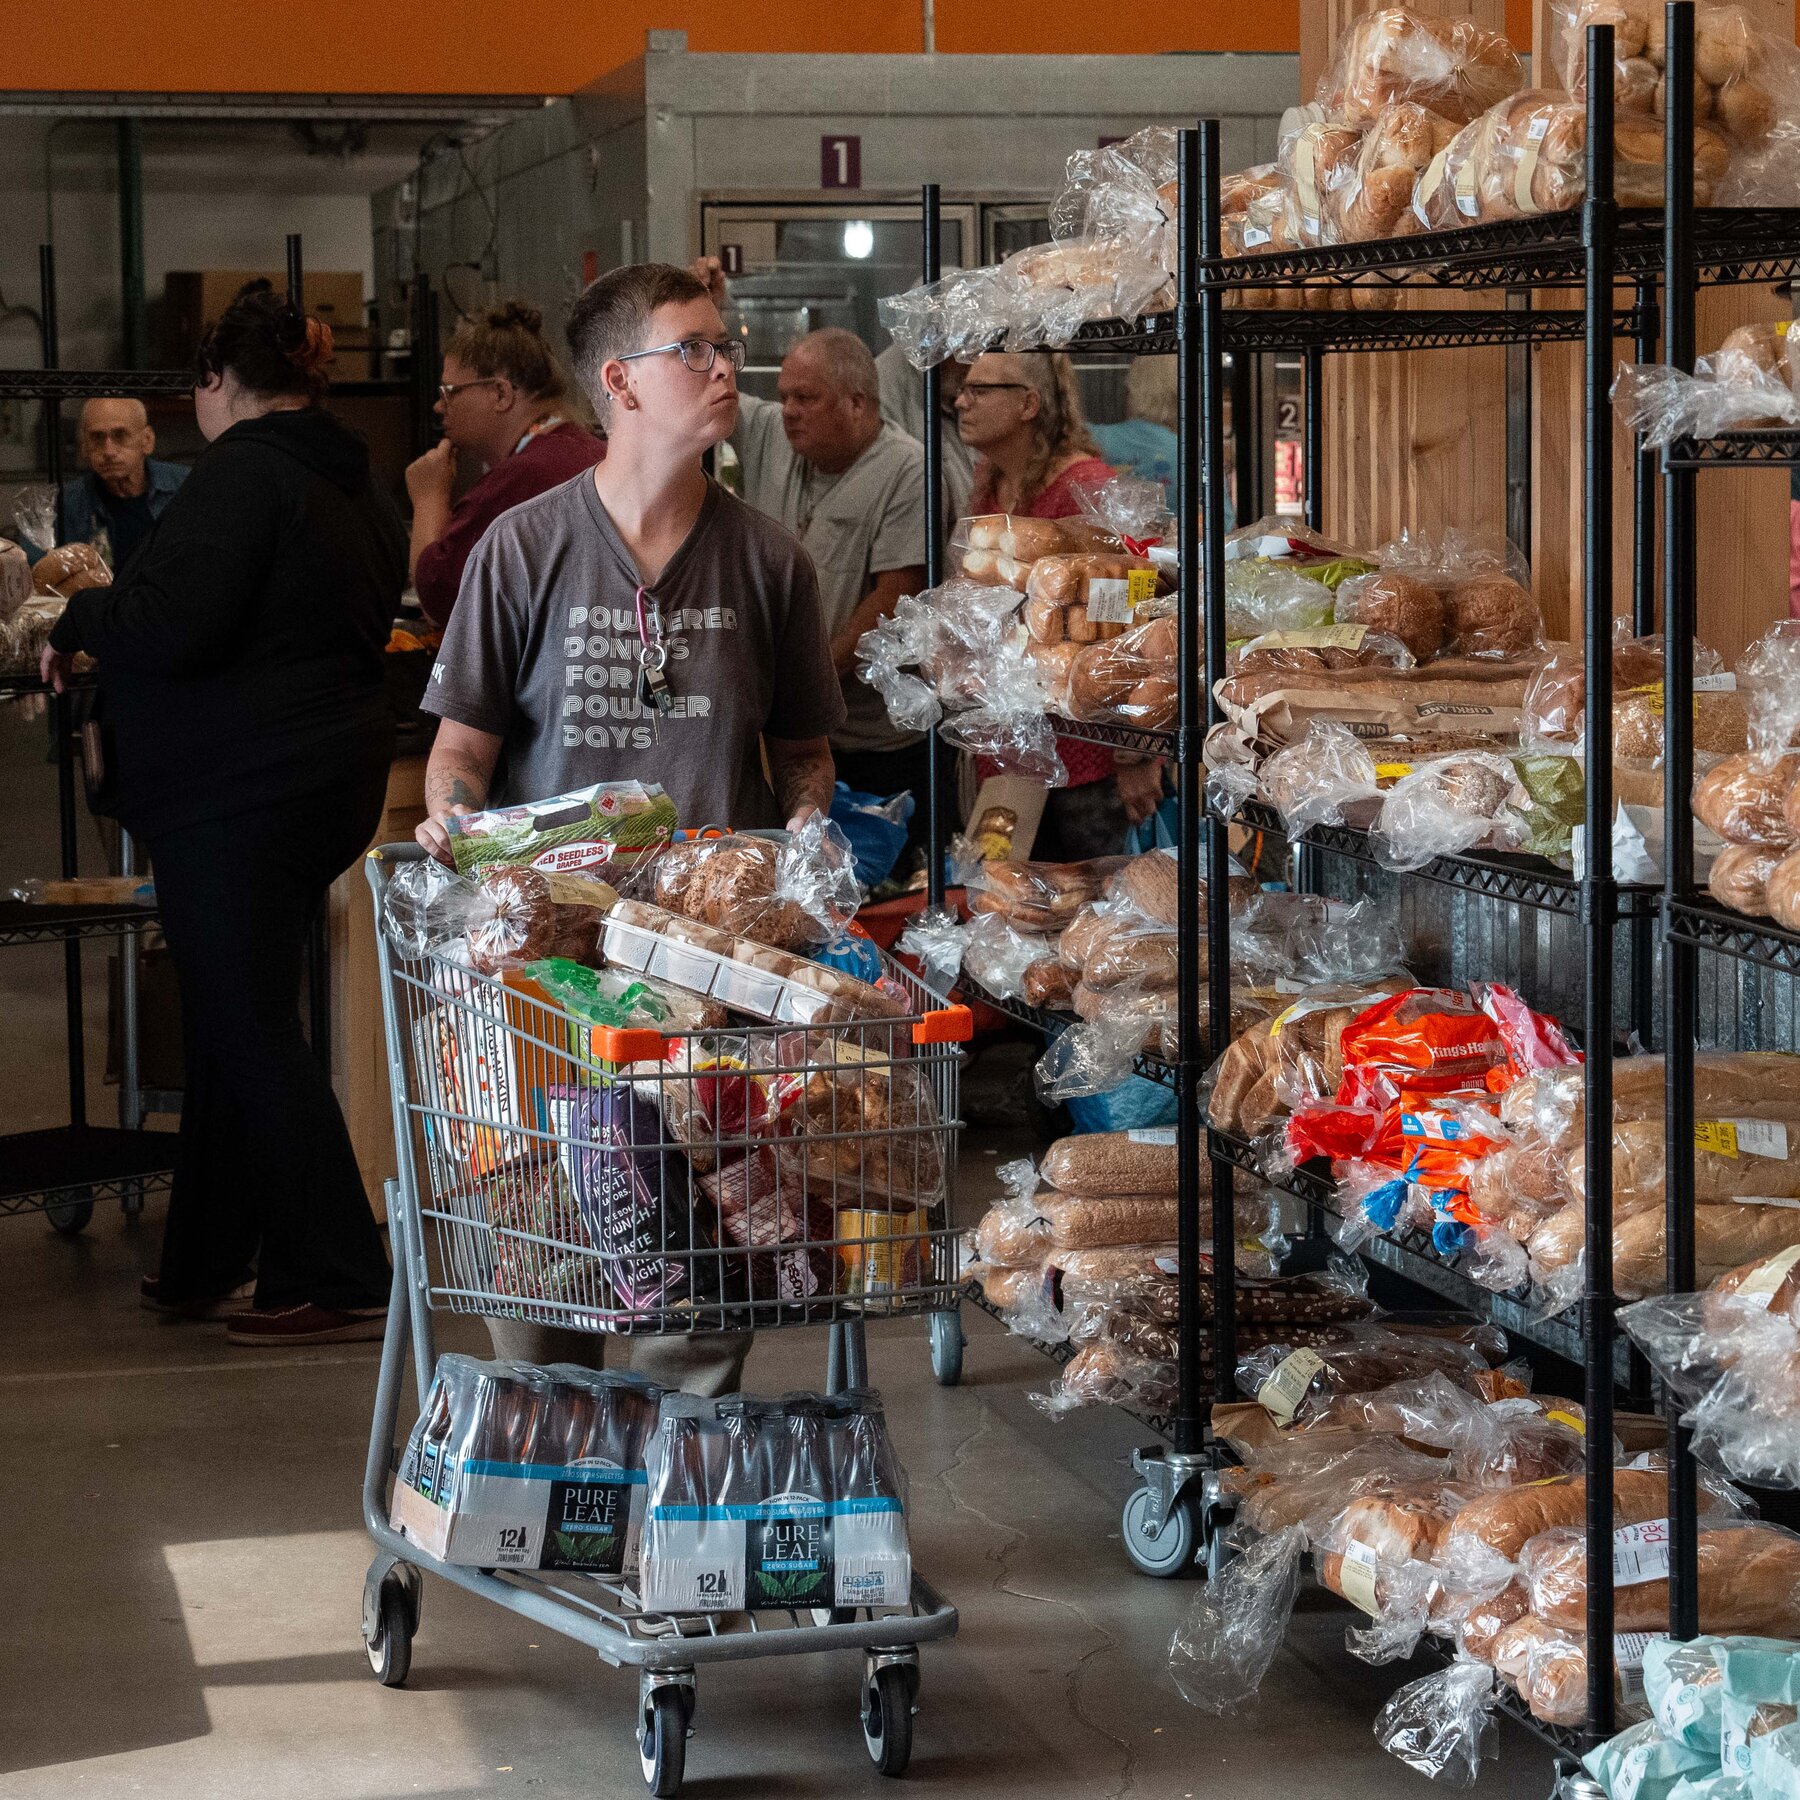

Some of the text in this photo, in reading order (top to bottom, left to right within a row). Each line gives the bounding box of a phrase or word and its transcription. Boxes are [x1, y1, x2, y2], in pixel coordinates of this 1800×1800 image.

[832, 142, 848, 184] 1
[726, 247, 737, 272] 1
[1281, 403, 1297, 428] 2
[565, 664, 633, 690] FOR
[1422, 704, 1488, 717] KIRKLAND
[1348, 723, 1387, 736] LAND
[557, 846, 604, 862] SEEDLESS
[556, 859, 582, 870] GRAPES
[1430, 1044, 1467, 1059] King's
[564, 1488, 618, 1506] PURE
[562, 1505, 617, 1523] LEAF
[565, 1524, 583, 1532] ZERO
[763, 1524, 820, 1543] PURE
[499, 1529, 518, 1548] 12
[763, 1542, 820, 1560] LEAF
[697, 1573, 717, 1593] 12
